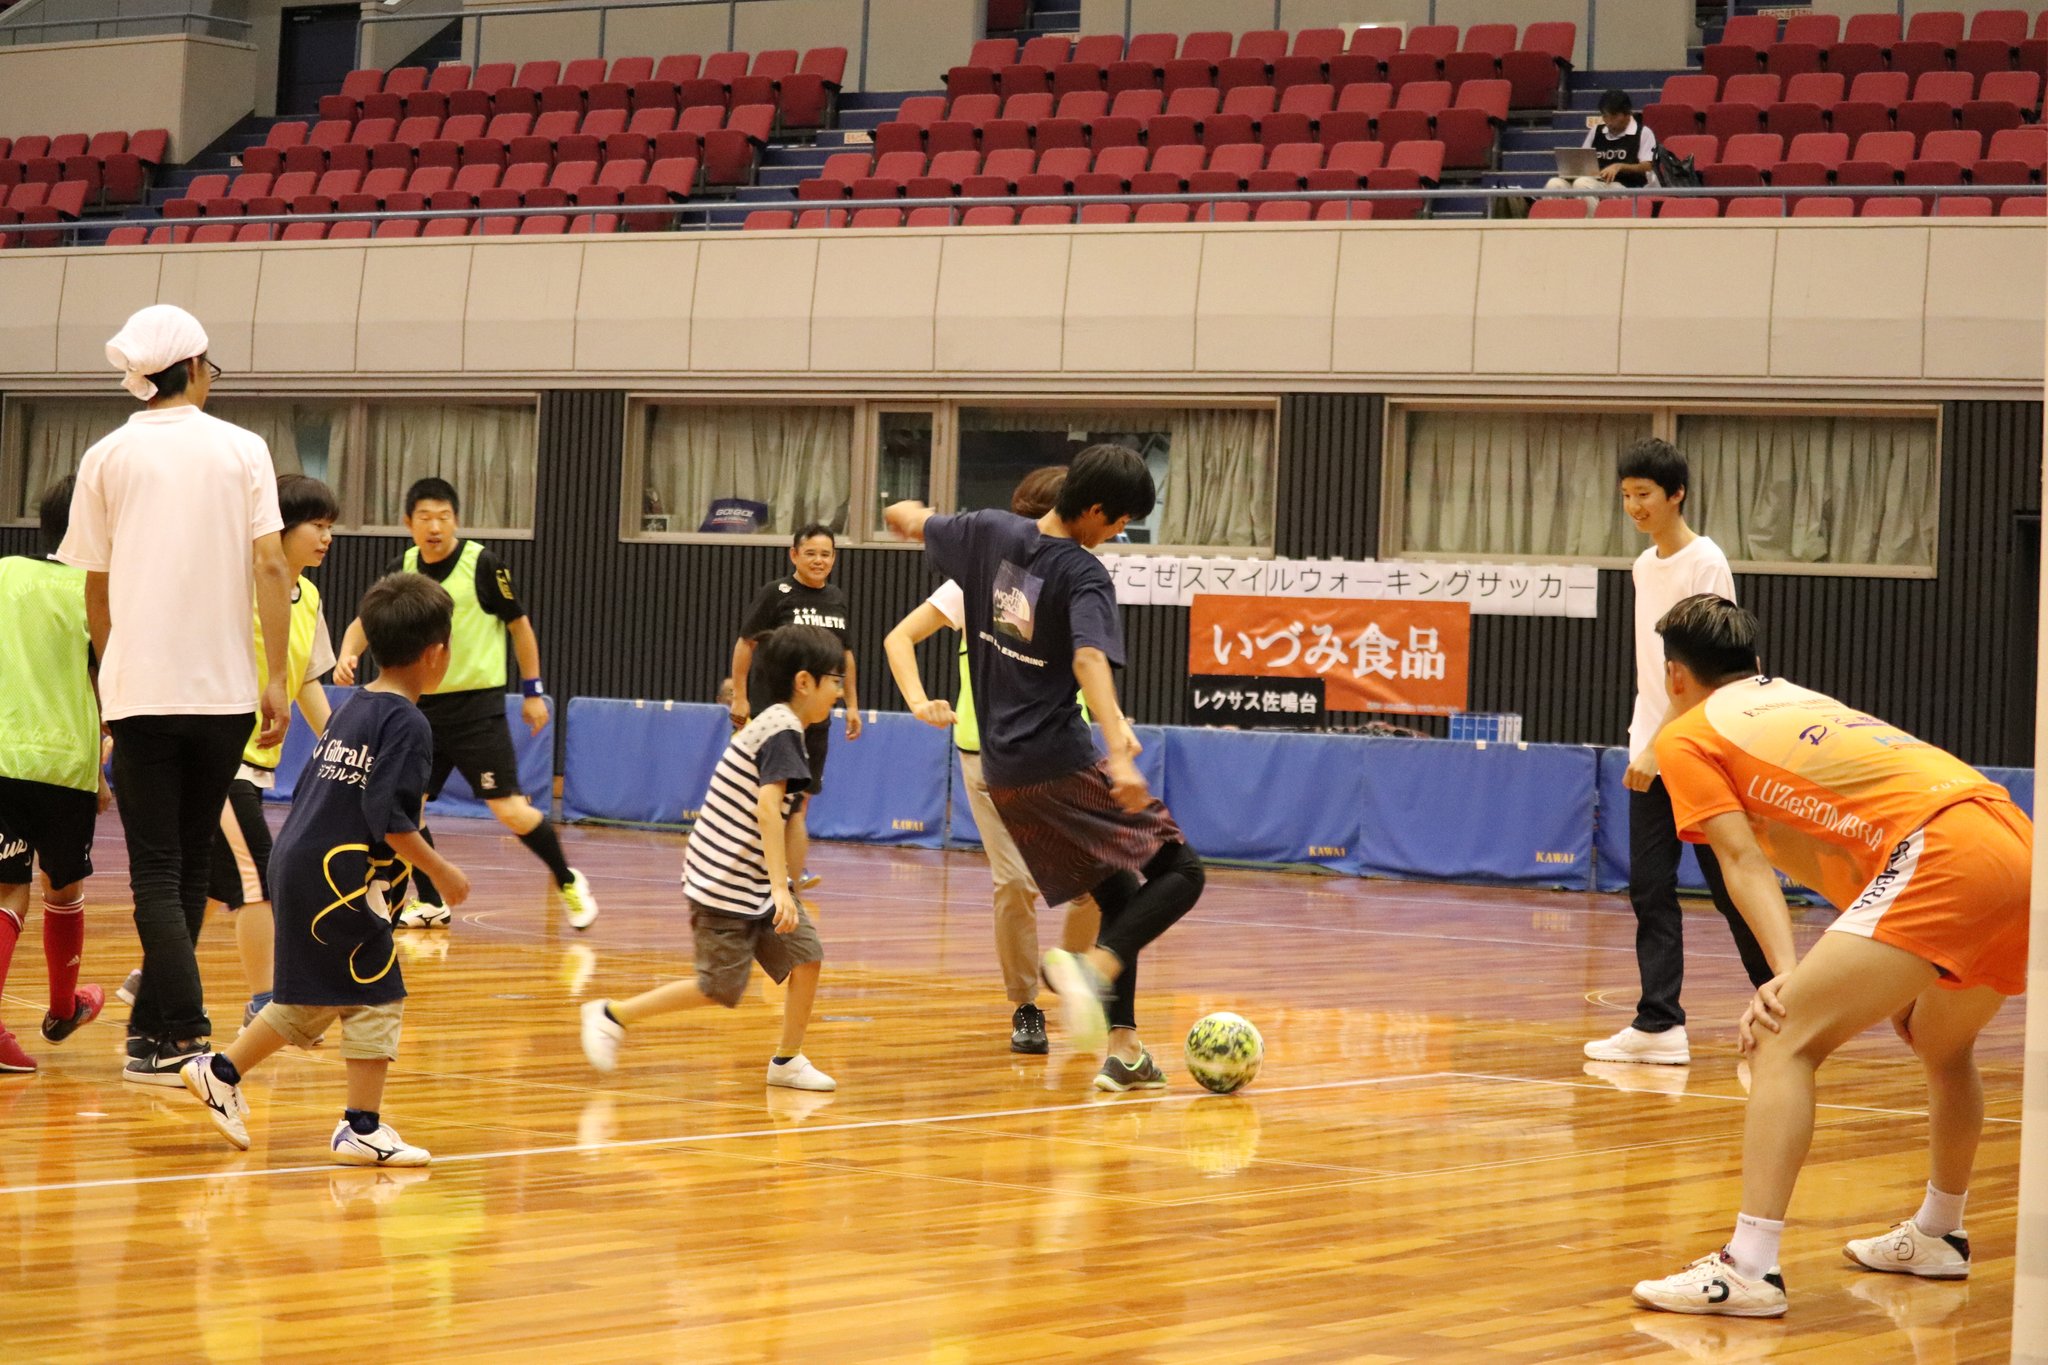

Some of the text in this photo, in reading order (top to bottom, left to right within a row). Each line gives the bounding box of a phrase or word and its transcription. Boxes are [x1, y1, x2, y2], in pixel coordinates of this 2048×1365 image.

[793, 614, 846, 630] ATHLETA
[1212, 620, 1446, 681] いづみ食品
[1193, 689, 1318, 715] レクサス佐鳴台
[1308, 845, 1346, 858] KAWAI
[1535, 851, 1575, 864] KAWAI
